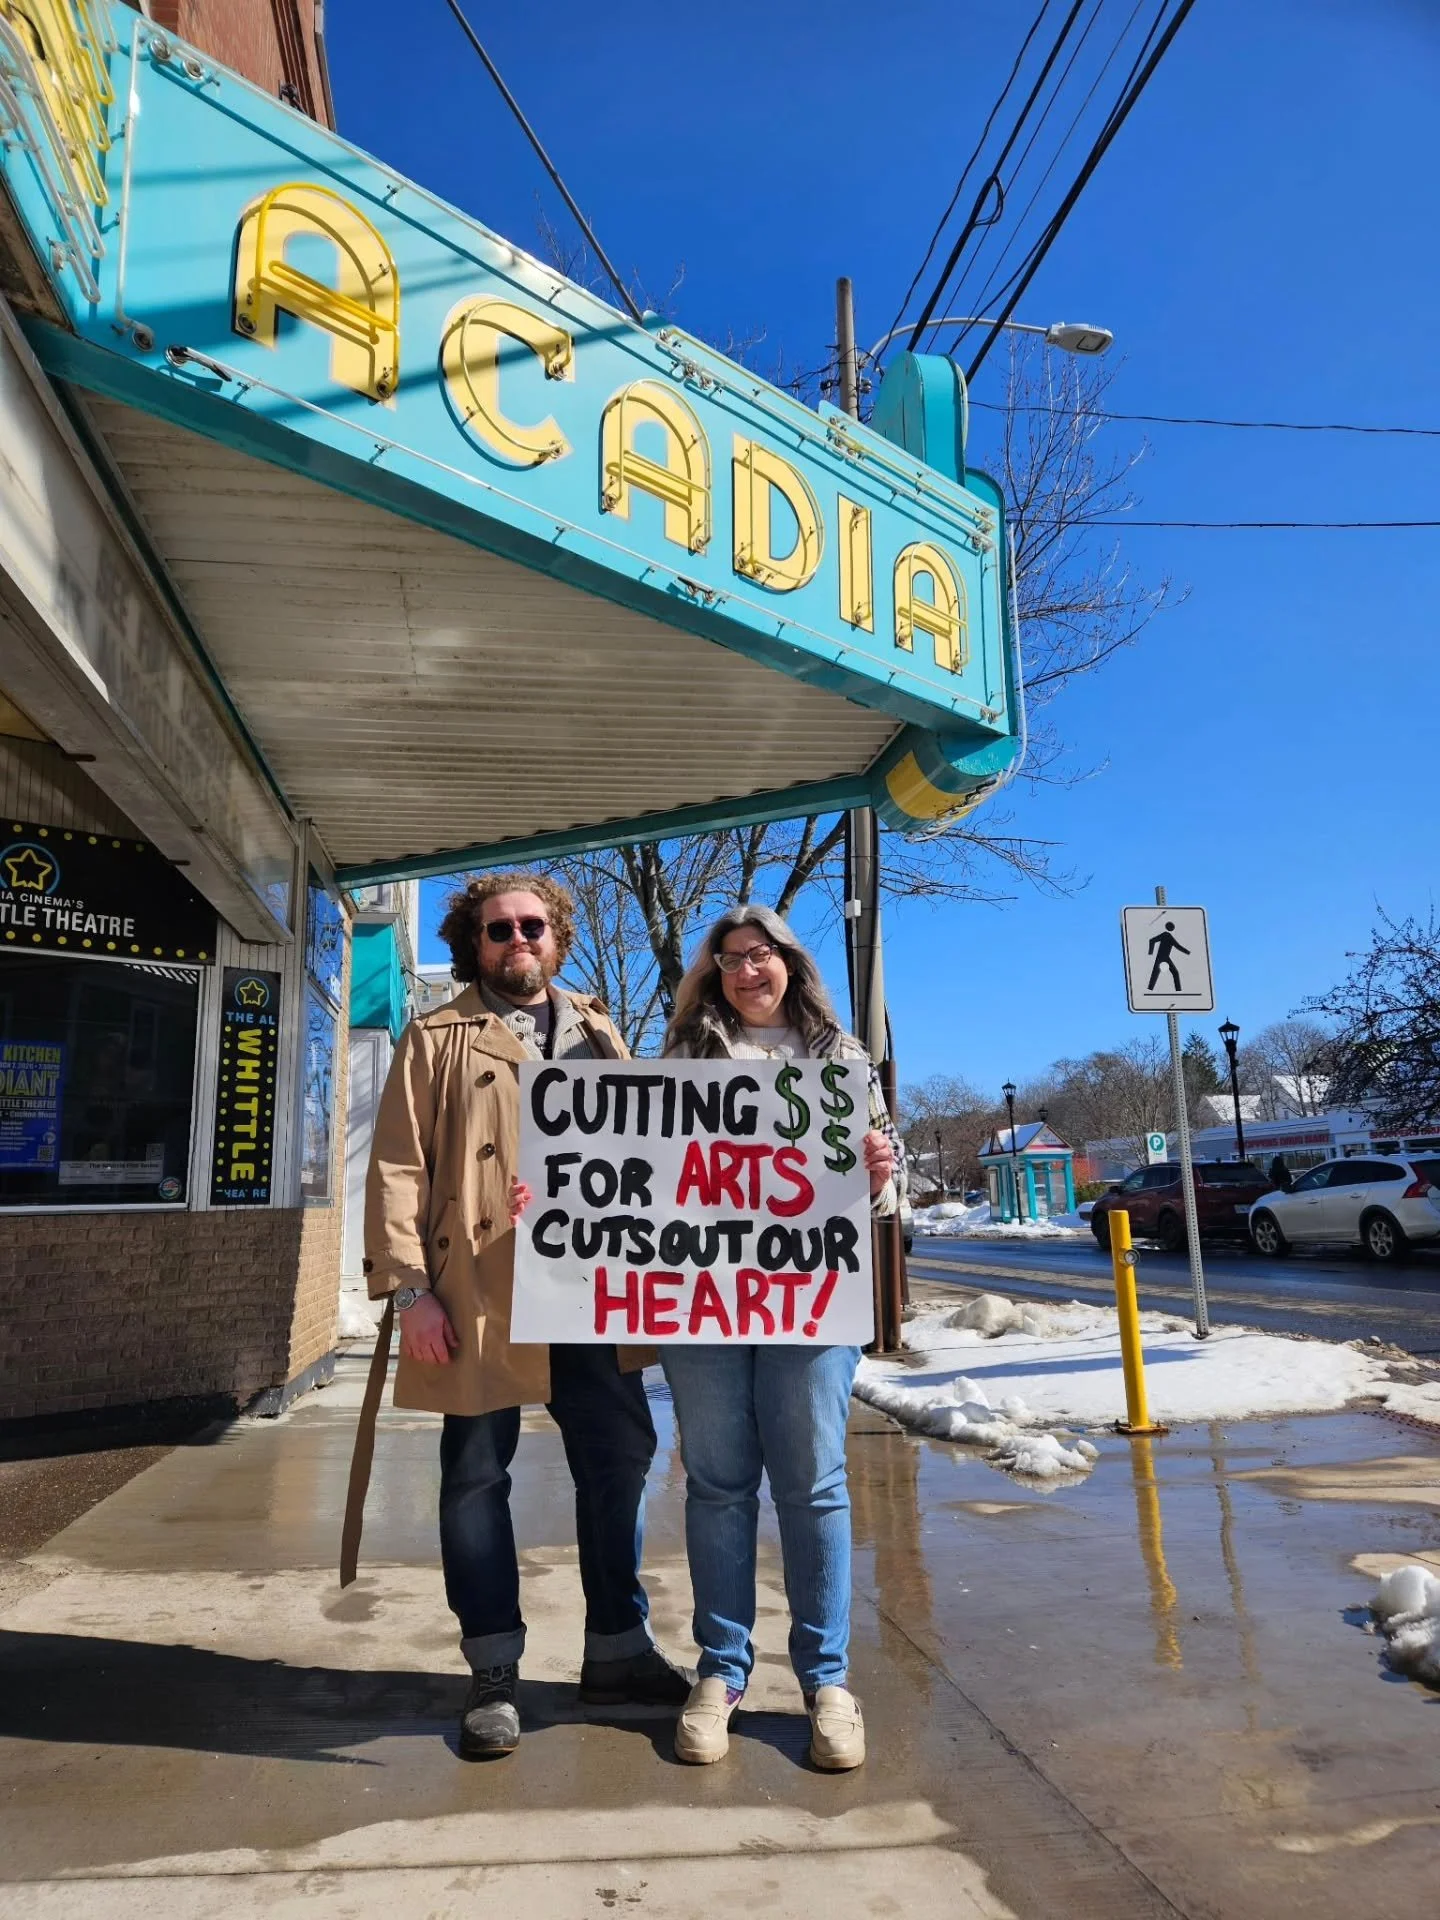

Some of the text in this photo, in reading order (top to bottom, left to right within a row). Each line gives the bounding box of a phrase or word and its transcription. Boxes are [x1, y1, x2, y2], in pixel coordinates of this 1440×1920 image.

[230, 181, 968, 674] ACADIA
[20, 893, 84, 909] CINEMA'S
[42, 908, 135, 937] THEATRE
[225, 1012, 276, 1025] THE AL
[231, 1029, 262, 1181] WHITTLE
[531, 1067, 761, 1138] CUTTING
[545, 1139, 815, 1217] FOR ARTS
[531, 1208, 860, 1273] CUTS OUT OUR
[594, 1265, 839, 1338] HEART!
